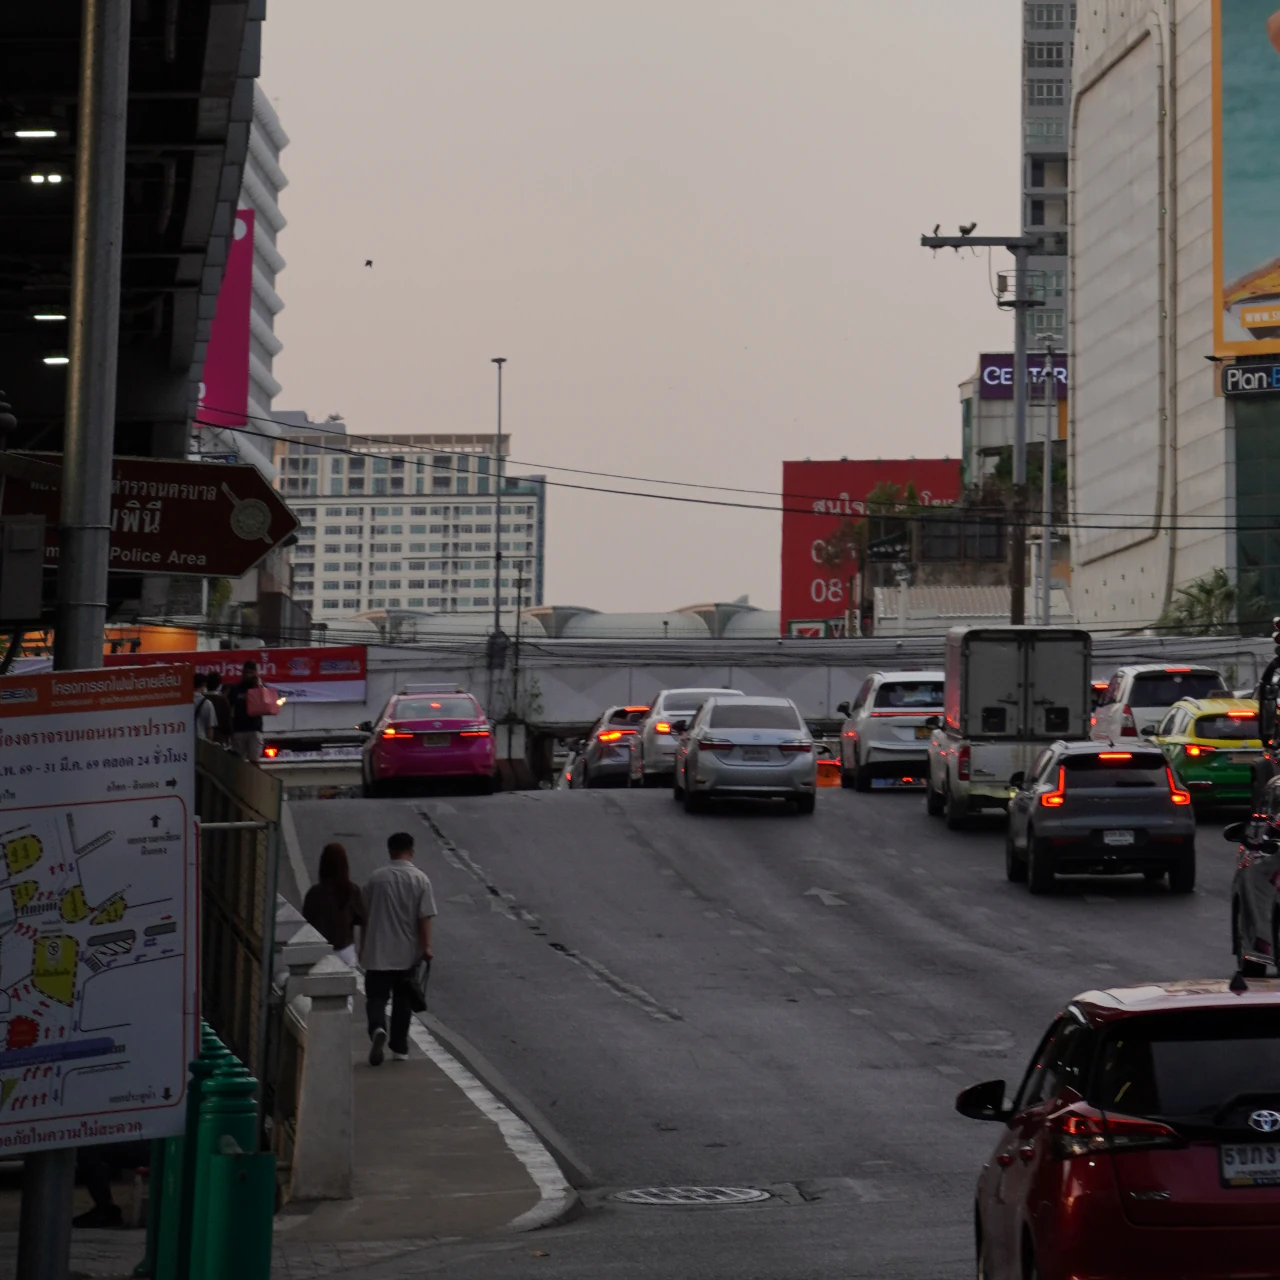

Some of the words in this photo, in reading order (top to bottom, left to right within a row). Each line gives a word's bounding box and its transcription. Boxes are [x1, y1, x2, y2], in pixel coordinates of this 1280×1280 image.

[110, 546, 161, 563] Police
[167, 550, 207, 566] Area
[154, 744, 188, 764] ชั่วโมง
